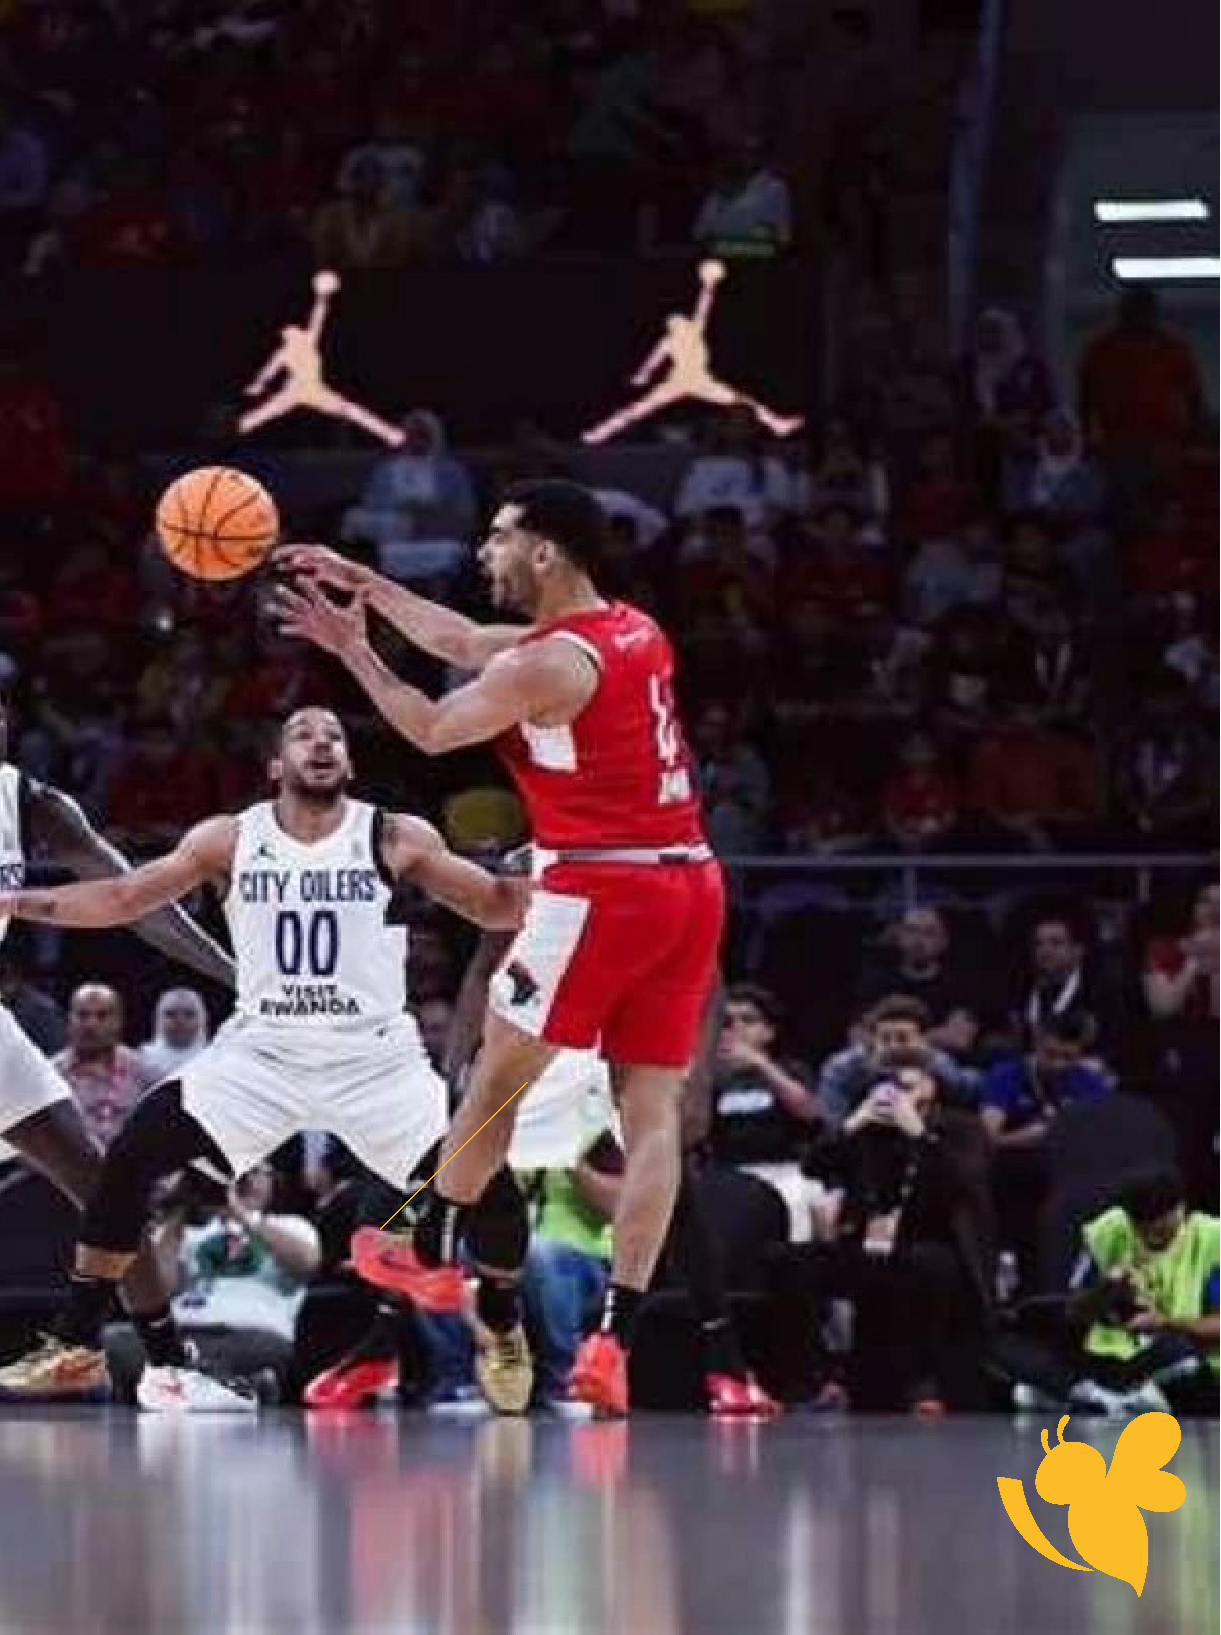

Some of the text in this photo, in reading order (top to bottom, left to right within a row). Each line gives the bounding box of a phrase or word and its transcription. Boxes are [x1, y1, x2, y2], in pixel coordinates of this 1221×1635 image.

[239, 869, 378, 903] CITY OILERS
[275, 910, 340, 976] 00
[281, 984, 338, 998] VISIT
[260, 998, 360, 1016] RWANDA
